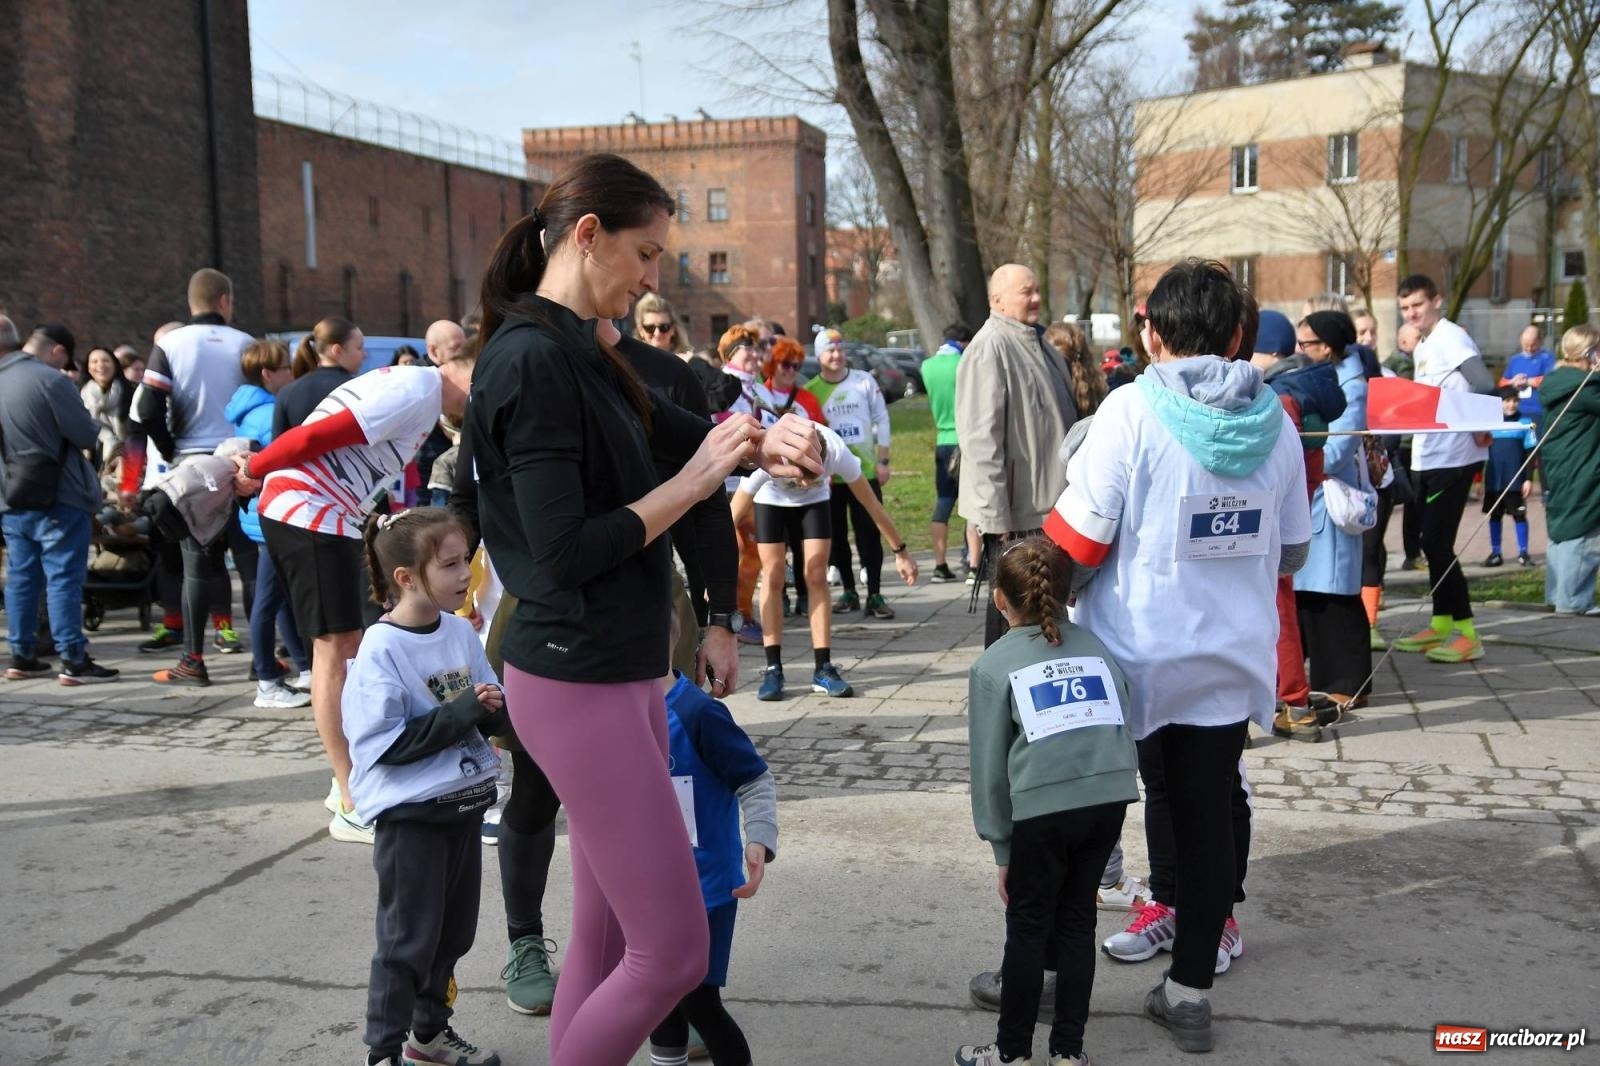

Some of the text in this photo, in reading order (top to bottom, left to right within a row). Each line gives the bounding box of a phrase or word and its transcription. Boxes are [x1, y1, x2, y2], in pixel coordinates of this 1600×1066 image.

[1221, 499, 1247, 508] WILCZYM
[1211, 512, 1240, 535] 64
[1057, 666, 1084, 674] WILCZYM
[1052, 678, 1087, 703] 76
